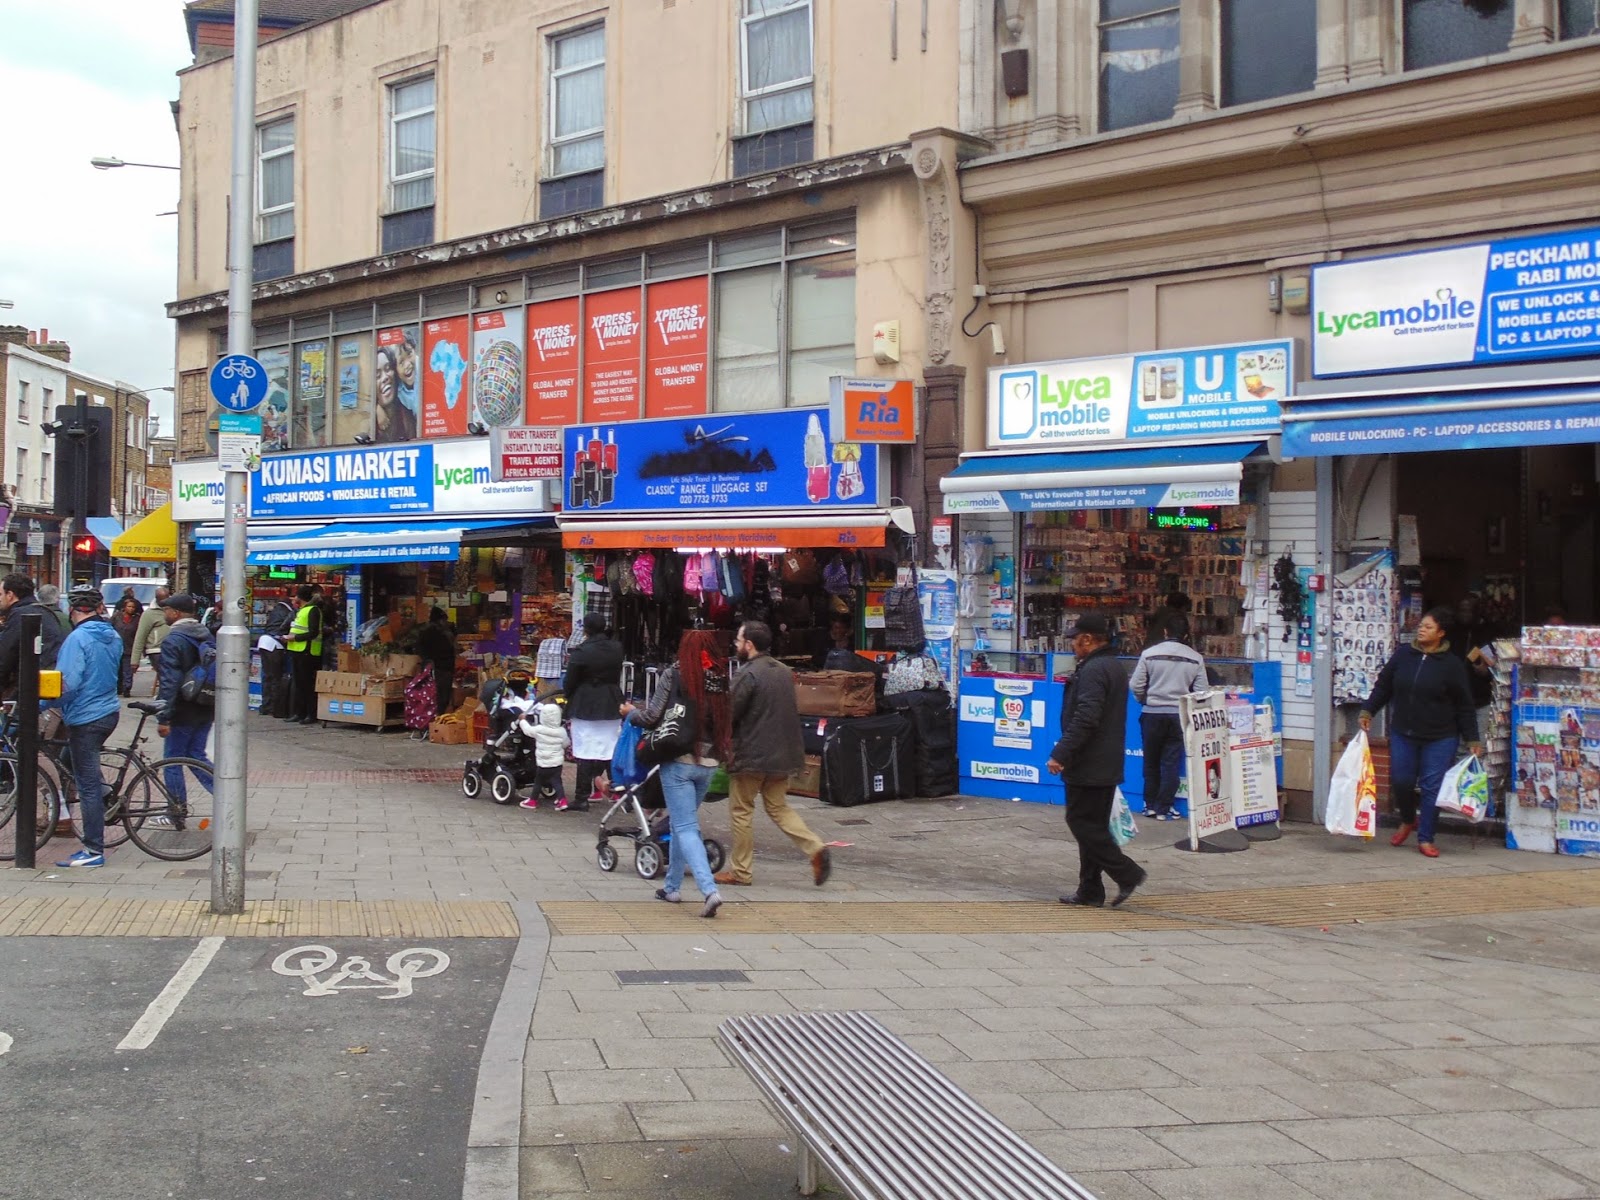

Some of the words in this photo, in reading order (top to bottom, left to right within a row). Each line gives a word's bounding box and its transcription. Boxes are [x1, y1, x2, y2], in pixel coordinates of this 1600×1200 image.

[1491, 242, 1589, 271] PECKHAM
[1517, 268, 1560, 286] RABI
[1497, 299, 1519, 312] WE
[1524, 292, 1584, 309] UNLOCK
[1590, 290, 1599, 302] &
[592, 312, 632, 328] XPRESS
[654, 305, 698, 323] XPRESS
[1318, 294, 1475, 337] Lycamobile
[1498, 313, 1552, 328] MOBILE
[603, 323, 639, 338] MONEY
[667, 316, 705, 333] MONEY
[1394, 328, 1408, 336] Call
[1424, 325, 1445, 333] world
[533, 324, 571, 340] XPRESS
[1498, 333, 1517, 345] PC
[1521, 332, 1531, 343] &
[1535, 326, 1592, 341] LAPTOP
[544, 335, 577, 350] MONEY
[655, 367, 679, 375] GLOBAL
[681, 363, 703, 372] MONEY
[1195, 355, 1224, 390] U
[533, 381, 553, 389] GLOBAL
[555, 378, 574, 387] MONEY
[662, 376, 695, 386] TRANSFER
[539, 390, 568, 399] TRANSFER
[1040, 374, 1110, 409] Lyca
[1189, 392, 1231, 403] MOBILE
[859, 396, 899, 423] Ria
[1040, 403, 1110, 426] mobile
[1148, 412, 1174, 420] MOBILE
[1177, 409, 1219, 418] UNLOCKING
[1229, 406, 1267, 415] REPARING
[1133, 424, 1161, 433] LAPTOP
[1162, 422, 1198, 431] REPARING
[1200, 420, 1228, 428] MOBILE
[1310, 431, 1346, 442] MOBILE
[1348, 429, 1405, 441] UNLOCKING
[1413, 427, 1427, 437] PC
[1435, 425, 1474, 436] LAPTOP
[1476, 420, 1551, 434] ACCESSORIES
[1554, 420, 1562, 429] &
[508, 431, 528, 439] MONEY
[529, 430, 556, 439] TRANSFER
[504, 444, 532, 452] INSTANTLY
[534, 443, 541, 451] TO
[543, 443, 562, 451] AFRICA
[509, 457, 532, 465] TRAVEL
[534, 456, 558, 464] AGENTS
[261, 456, 331, 486] KUMASI
[335, 450, 419, 482] MARKET
[505, 469, 527, 477] AFRICA
[435, 463, 489, 490] Lycam
[179, 480, 224, 501] Lycamo
[267, 493, 298, 503] AFRICAN
[300, 491, 324, 501] FOODS
[332, 489, 378, 500] WHOLESALE
[380, 488, 386, 498] &
[388, 486, 417, 498] RETAIL
[482, 486, 493, 494] Call
[646, 486, 675, 495] CLASSIC
[681, 484, 706, 494] RANGE
[712, 484, 750, 493] LUGGAGE
[755, 482, 767, 491] SET
[1052, 491, 1084, 499] favourite
[1171, 487, 1234, 501] Lycamobile
[680, 495, 692, 504] 020
[693, 495, 709, 503] 7732
[711, 495, 728, 503] 9733
[948, 496, 1000, 508] Lycamobile
[1031, 500, 1076, 508] International
[1158, 516, 1209, 527] UNLOCKING
[579, 536, 594, 545] Ria
[672, 535, 684, 544] Way
[696, 534, 712, 542] Send
[714, 534, 736, 544] Money
[838, 531, 857, 543] Ria
[968, 703, 994, 716] Lyca
[1005, 703, 1022, 712] 150
[1192, 710, 1226, 731] BARBER
[1201, 741, 1220, 757] £5.00
[975, 763, 1033, 777] Lycamobile
[1204, 803, 1225, 816] LADIES
[1198, 818, 1212, 830] HAIR
[1213, 814, 1232, 826] SALON
[1238, 816, 1250, 825] 0207
[1252, 814, 1261, 822] 121
